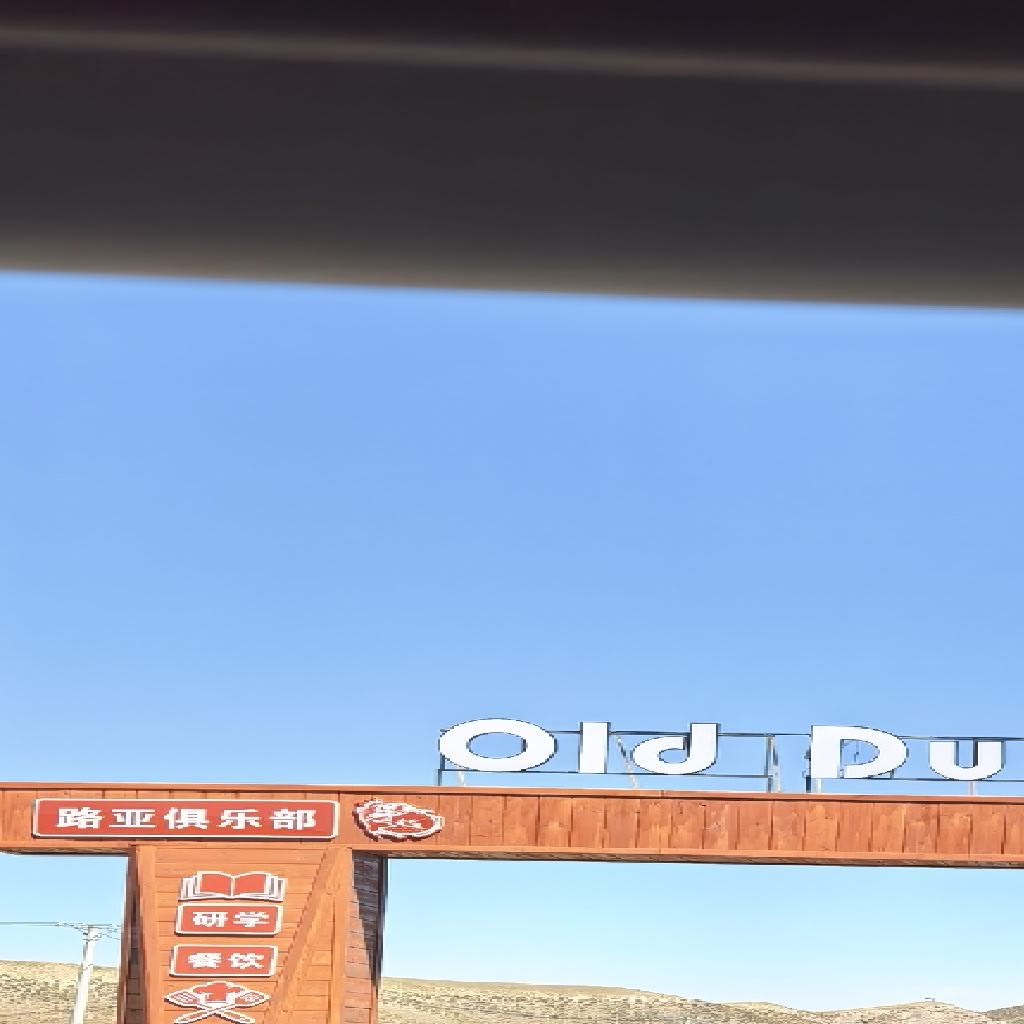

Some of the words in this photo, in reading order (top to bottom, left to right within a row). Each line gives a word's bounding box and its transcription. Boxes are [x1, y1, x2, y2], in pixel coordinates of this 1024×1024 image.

[438, 718, 719, 775] Old
[56, 807, 317, 830] 路亚俱乐部
[193, 912, 270, 928] 研学
[188, 953, 264, 969] 餐饮
